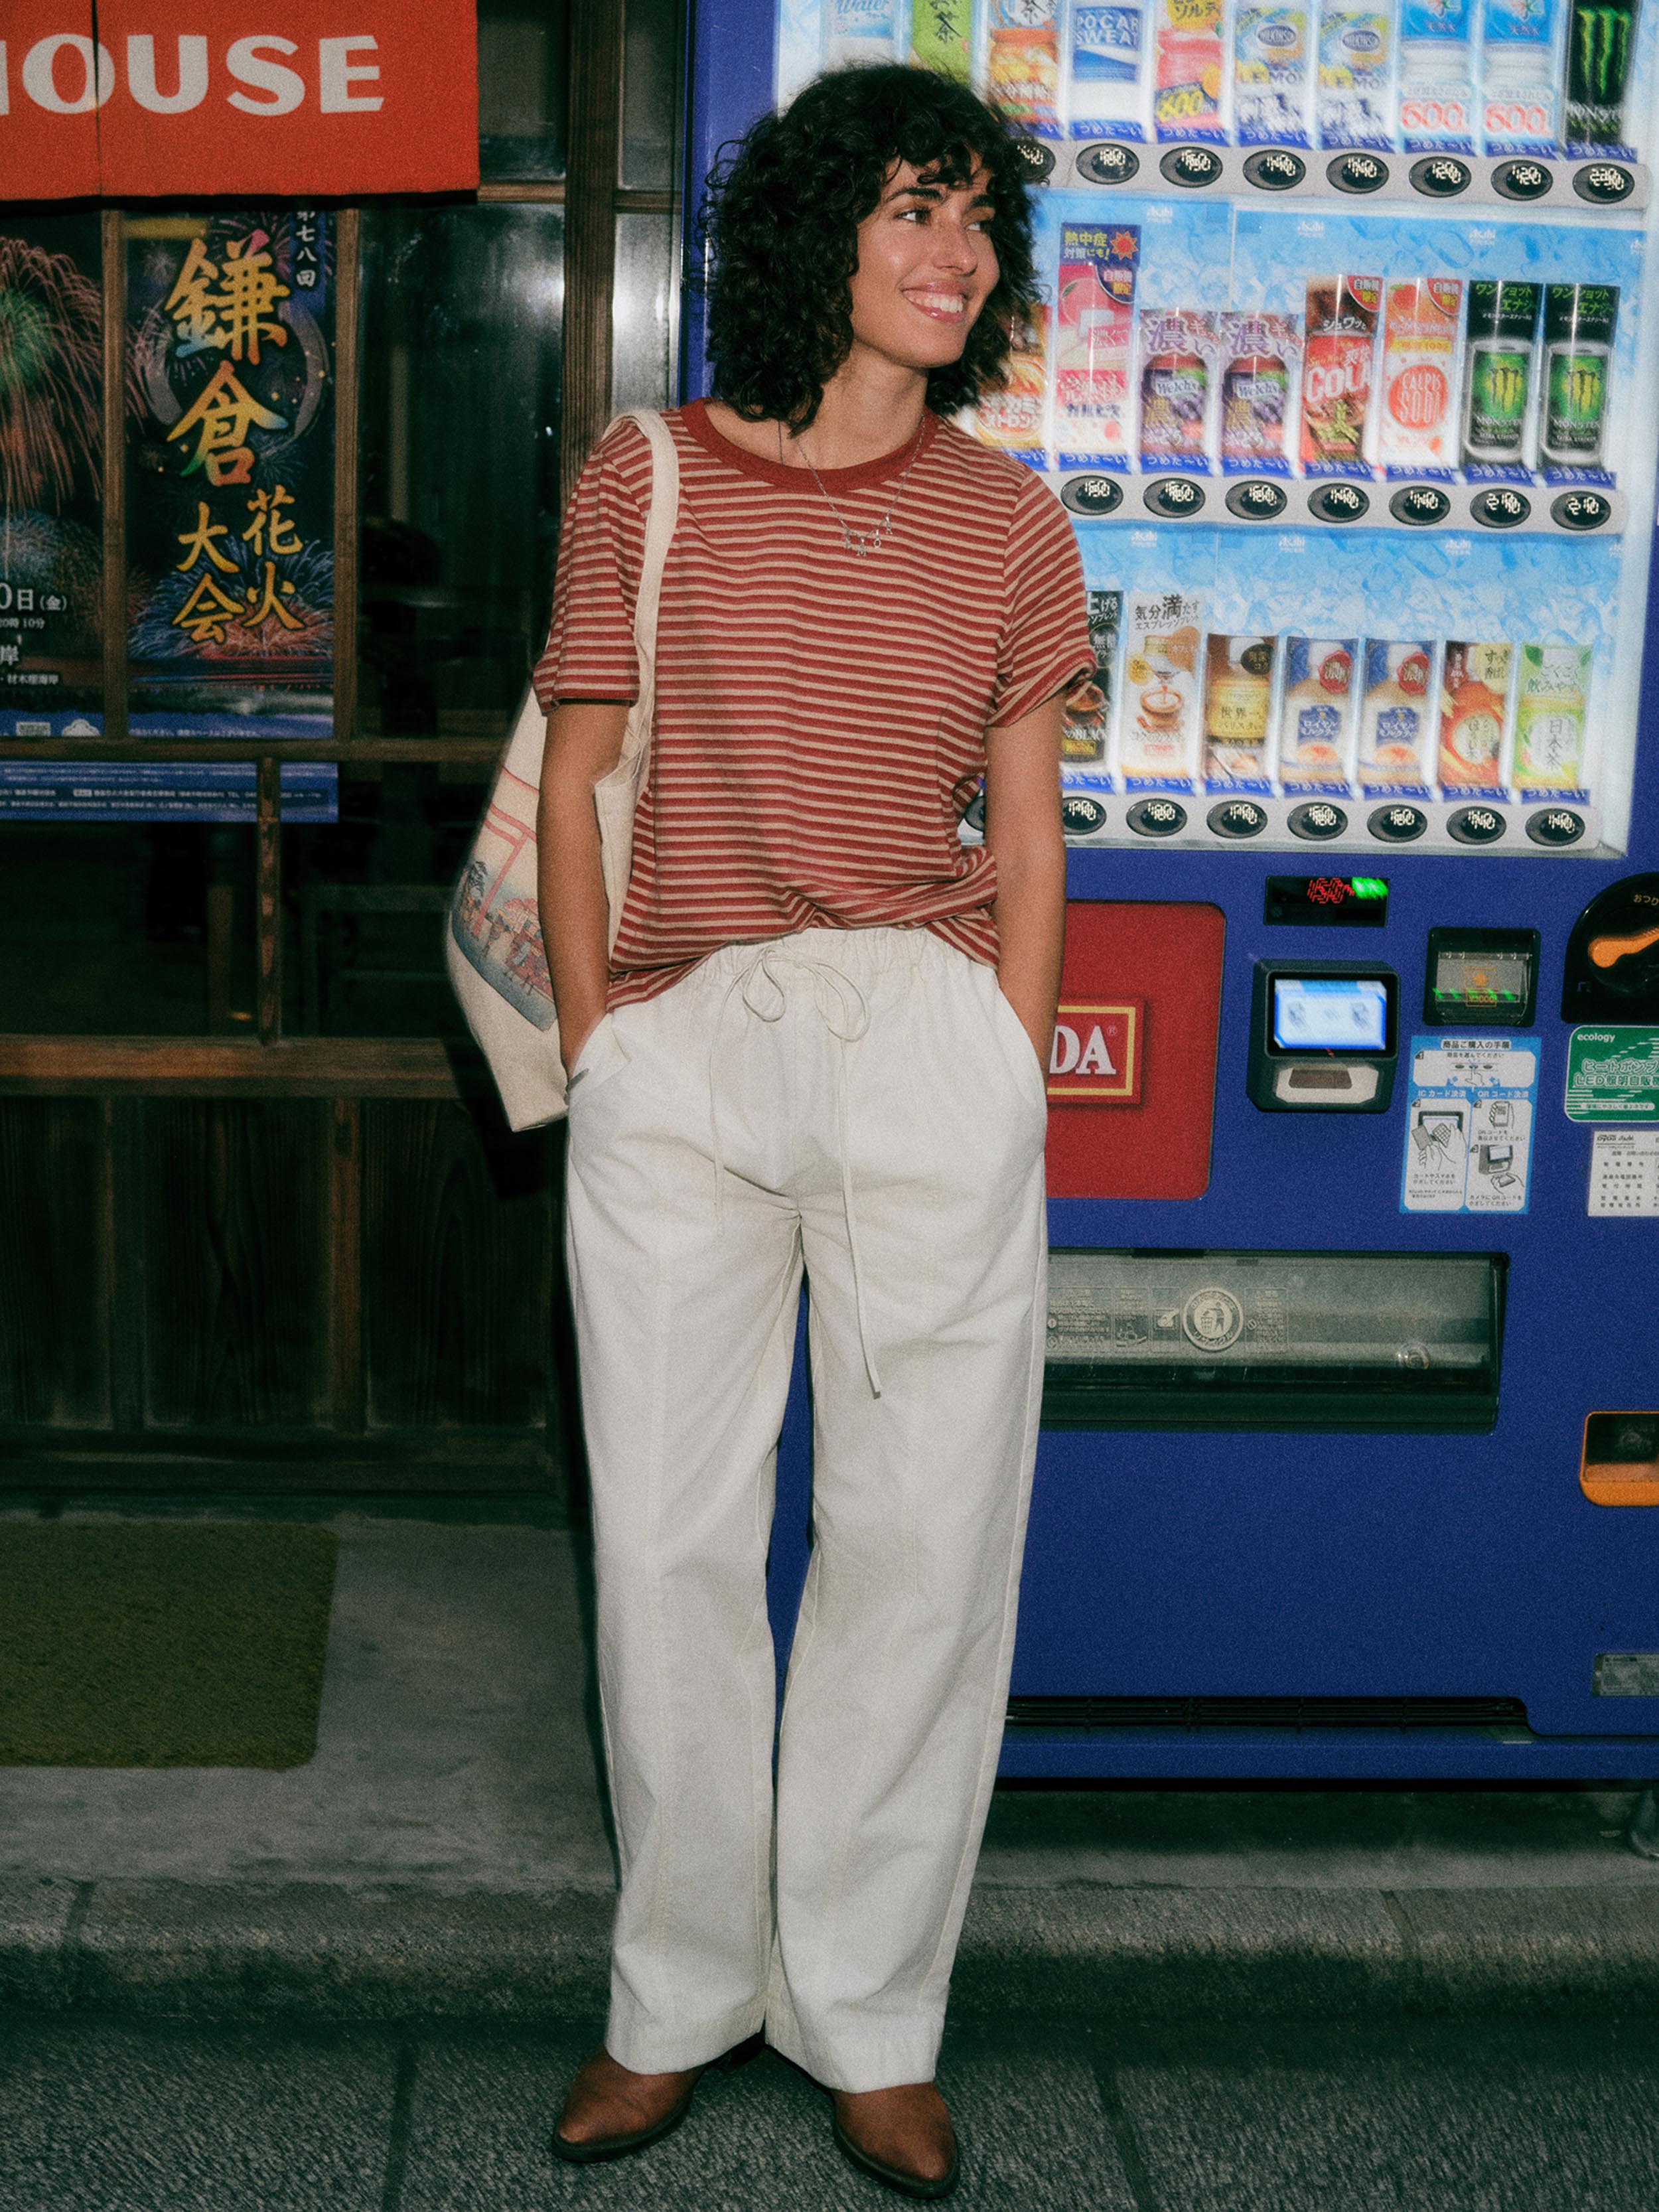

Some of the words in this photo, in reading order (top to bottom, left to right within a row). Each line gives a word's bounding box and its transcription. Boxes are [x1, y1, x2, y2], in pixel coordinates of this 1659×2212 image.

[0, 33, 384, 115] OUSE
[1402, 101, 1463, 130] 600
[1485, 104, 1547, 132] 600
[172, 501, 245, 644] 大会
[242, 484, 306, 630] 花火
[1577, 1032, 1616, 1043] ecology
